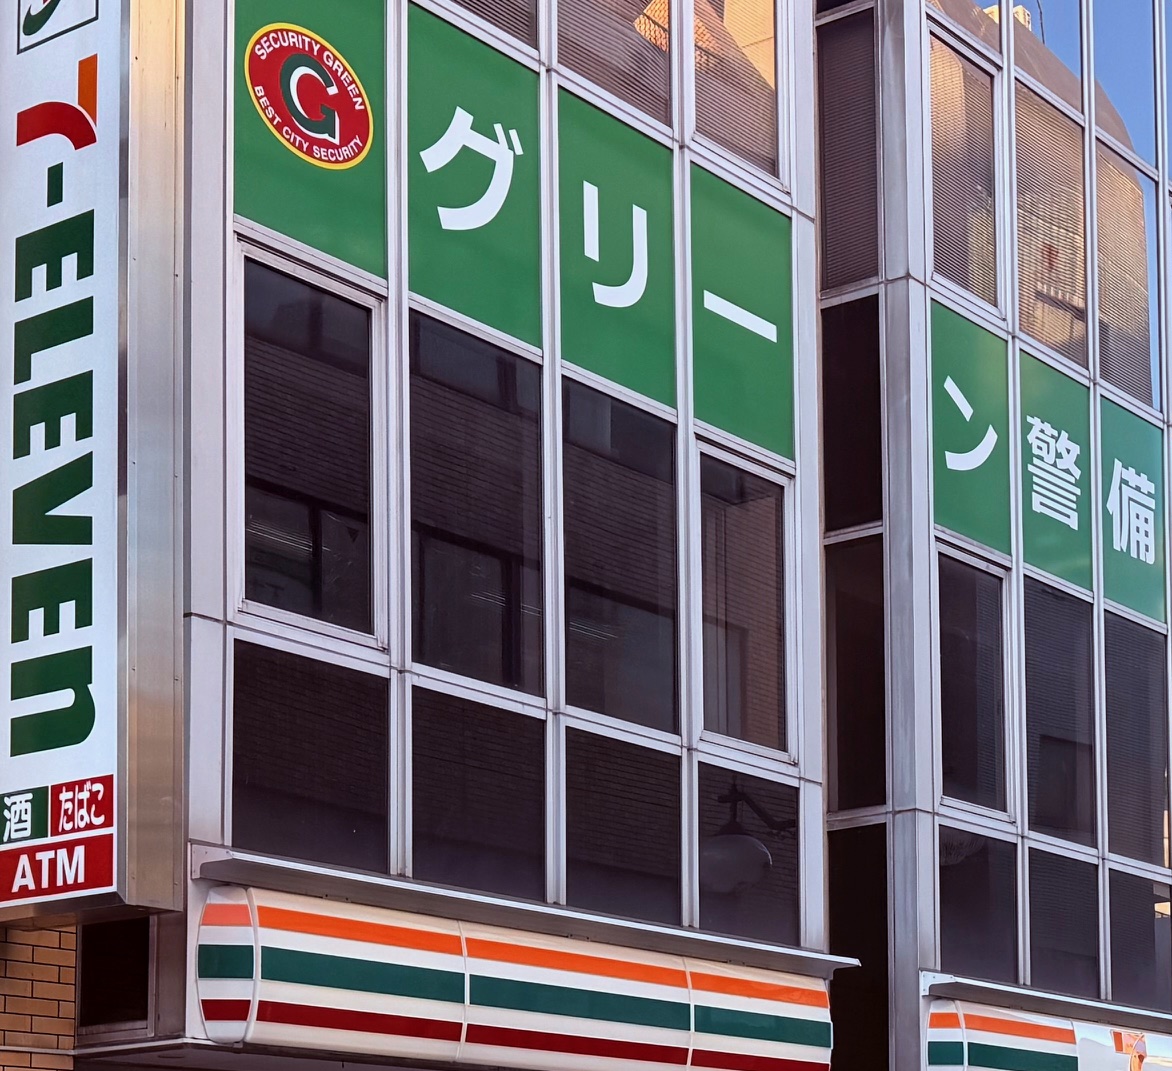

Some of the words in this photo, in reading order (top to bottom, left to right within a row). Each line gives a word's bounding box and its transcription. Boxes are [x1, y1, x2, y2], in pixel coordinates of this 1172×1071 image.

[255, 31, 320, 60] SECURITY
[323, 50, 364, 111] GREEN
[254, 85, 282, 126] BEST
[282, 126, 309, 152] CITY
[313, 135, 363, 161] SECURITY
[3, 792, 34, 843] 酒
[59, 780, 105, 833] たばこ
[11, 845, 86, 893] ATM
